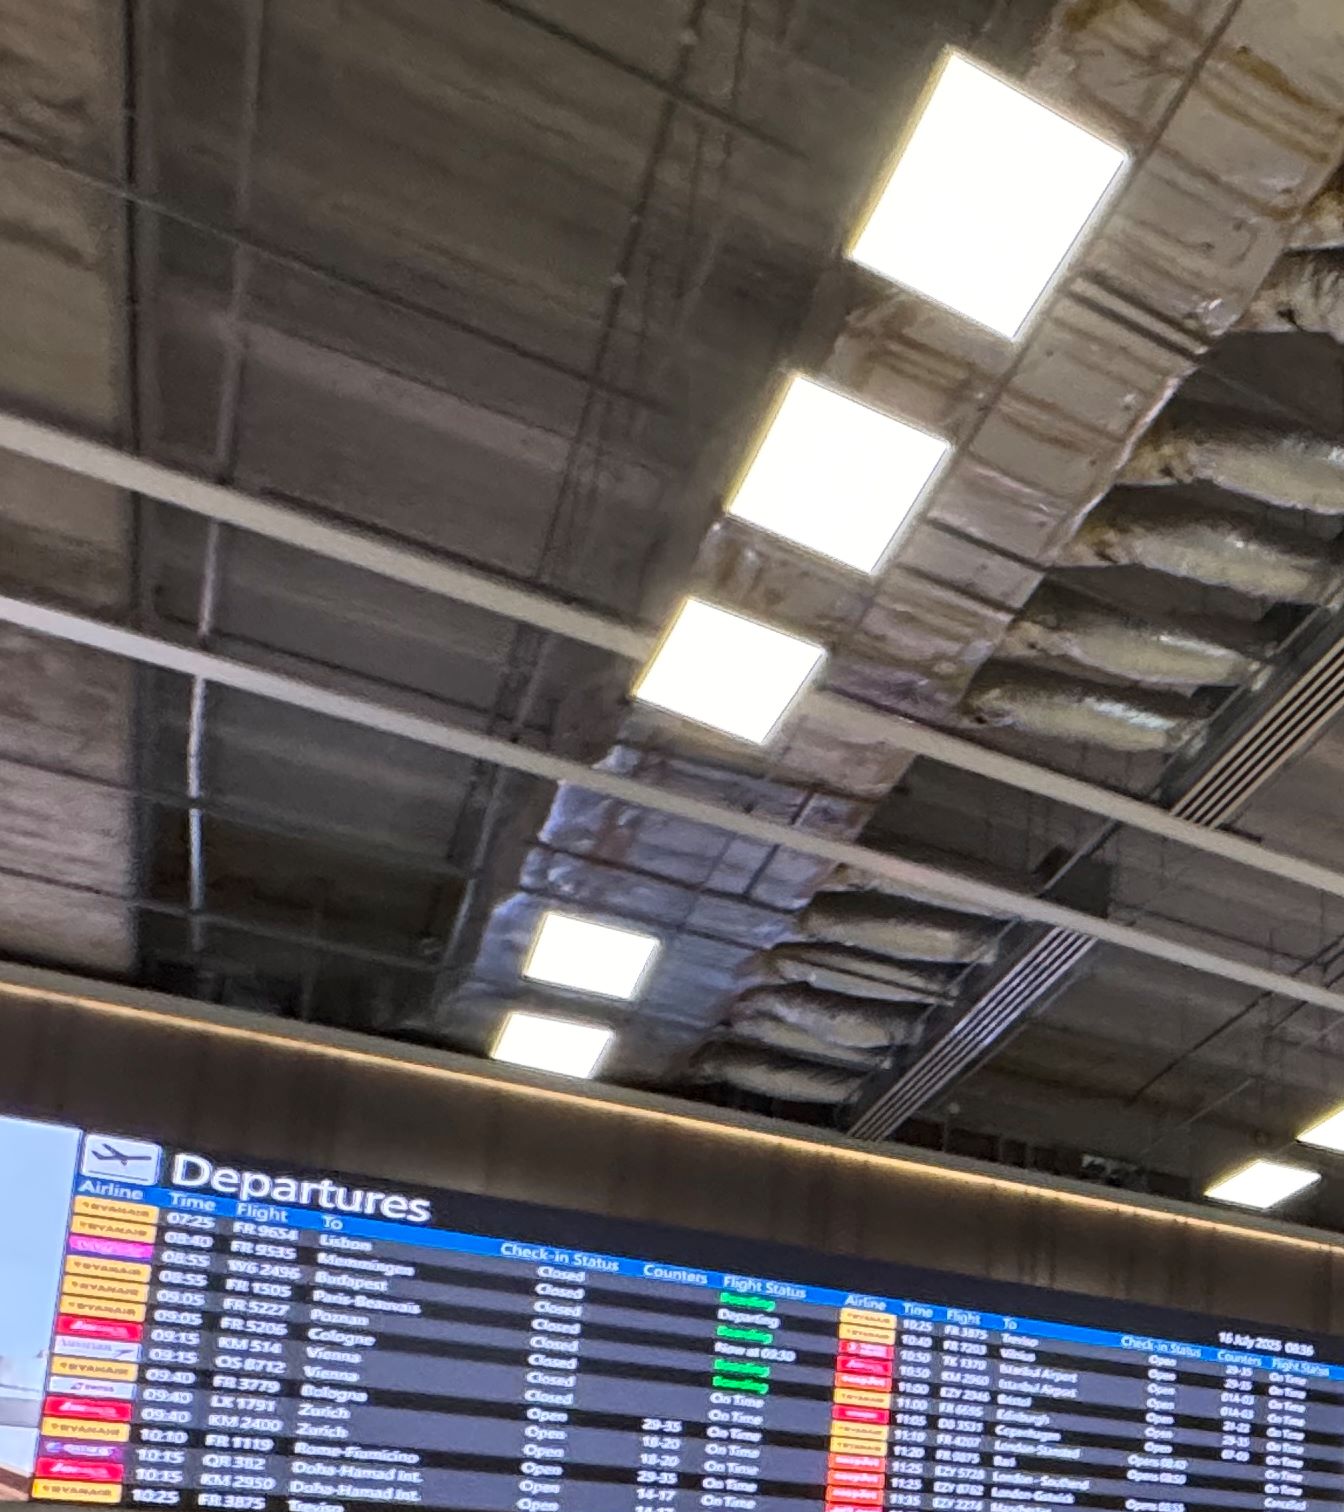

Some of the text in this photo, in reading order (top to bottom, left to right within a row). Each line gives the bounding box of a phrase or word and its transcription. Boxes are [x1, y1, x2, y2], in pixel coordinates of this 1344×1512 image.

[172, 1152, 431, 1222] Departures
[78, 1180, 807, 1298] Airline Time Flight To Check-in Status Counters Flight Status
[166, 1212, 586, 1282] 07:25 FR 9654 Lisbon Closed
[159, 1271, 208, 1288] 08:55
[532, 1319, 581, 1335] Closed
[161, 1251, 211, 1268] 08:55
[315, 1271, 388, 1292] Budapest
[534, 1301, 583, 1317] Closed
[231, 1241, 253, 1255] FR
[535, 1284, 584, 1300] Closed
[717, 1308, 781, 1329] Departing
[154, 1311, 203, 1327] 09:05
[220, 1318, 243, 1333] FR
[307, 1328, 376, 1346] Cologne
[528, 1354, 577, 1370] Closed
[223, 1299, 246, 1313] FR
[247, 1301, 290, 1318] 5227
[310, 1309, 369, 1326] Poznan
[530, 1337, 579, 1352] Closed
[845, 1295, 887, 1311] Airline
[902, 1302, 935, 1318] Time
[946, 1309, 981, 1326] Flight
[1003, 1317, 1018, 1330] To
[1120, 1335, 1167, 1352] Check-in
[1217, 1350, 1262, 1367] Counters
[1271, 1357, 1301, 1372] Flight
[1234, 1334, 1254, 1349] July
[149, 1350, 764, 1425] 09:15 OS 8712 Vienna Closed On Time
[151, 1330, 765, 1408] 09:15 KM 514 Vienna Closed On Time
[1147, 1369, 1176, 1382] Open
[1147, 1383, 1176, 1397] Open
[1148, 1354, 1177, 1368] Open
[144, 1389, 761, 1459] 09:40 LX 1791 Zurich Open On Time
[147, 1370, 195, 1386] 09:40
[213, 1376, 237, 1391] FR
[239, 1378, 280, 1395] 3779
[301, 1384, 368, 1402] Bologna
[526, 1407, 568, 1423] Open
[706, 1426, 728, 1439] On
[729, 1427, 762, 1442] Time
[1145, 1413, 1174, 1426] Open
[1145, 1427, 1174, 1440] Open
[1146, 1398, 1175, 1412] Open
[139, 1429, 188, 1445] 10:10
[205, 1434, 230, 1449] FR
[232, 1436, 274, 1452] 1119
[520, 1462, 563, 1477] Open
[702, 1477, 724, 1490] On
[725, 1479, 758, 1493] Time
[142, 1409, 760, 1476] 09:40 KM 2400 Zurich Open On Time
[1144, 1442, 1173, 1455] Open
[132, 1488, 180, 1504] 10:25
[198, 1492, 221, 1507] FR
[134, 1468, 183, 1484] 10:15
[200, 1473, 230, 1488] KM
[517, 1498, 560, 1512] Open
[137, 1449, 185, 1465] 10:15
[519, 1480, 561, 1495] Open
[700, 1494, 723, 1507] On
[724, 1496, 757, 1510] Time
